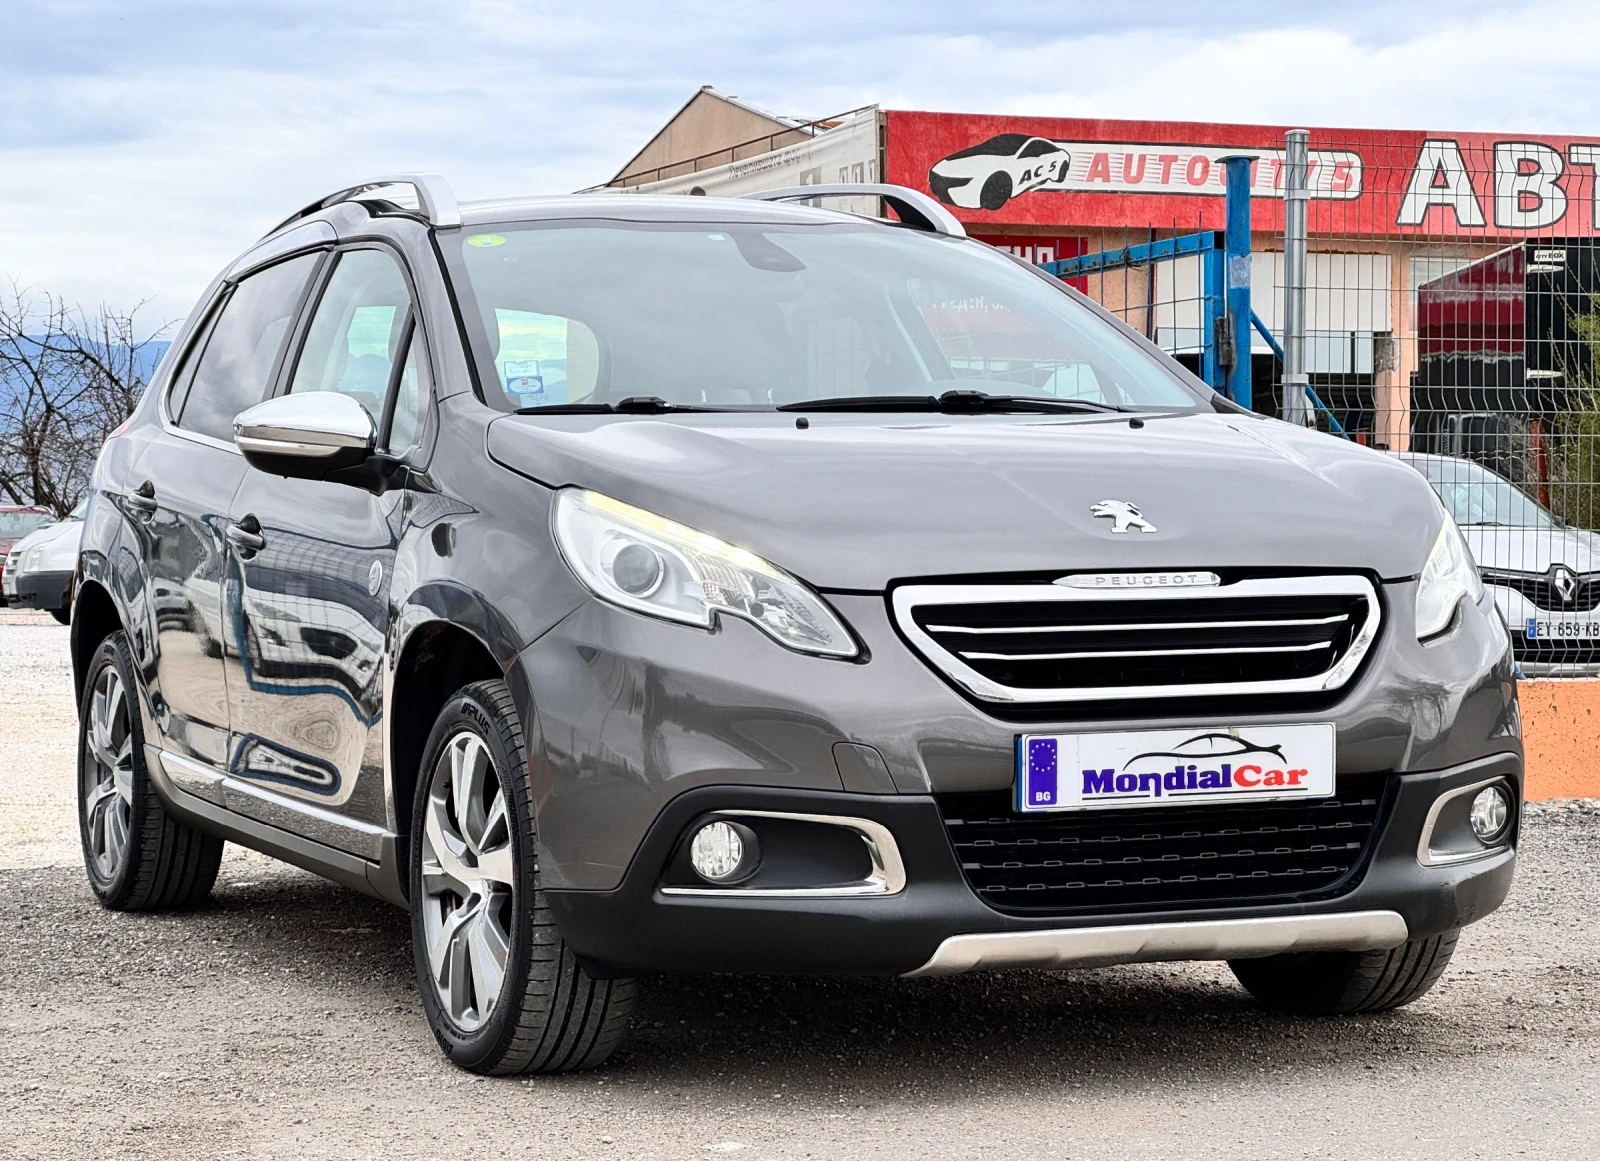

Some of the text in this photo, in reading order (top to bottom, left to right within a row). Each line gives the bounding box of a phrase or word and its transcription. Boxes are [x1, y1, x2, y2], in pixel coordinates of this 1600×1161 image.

[1095, 574, 1197, 586] PEUGEOT
[1082, 764, 1309, 797] MondialCar
[1035, 791, 1051, 802] BG
